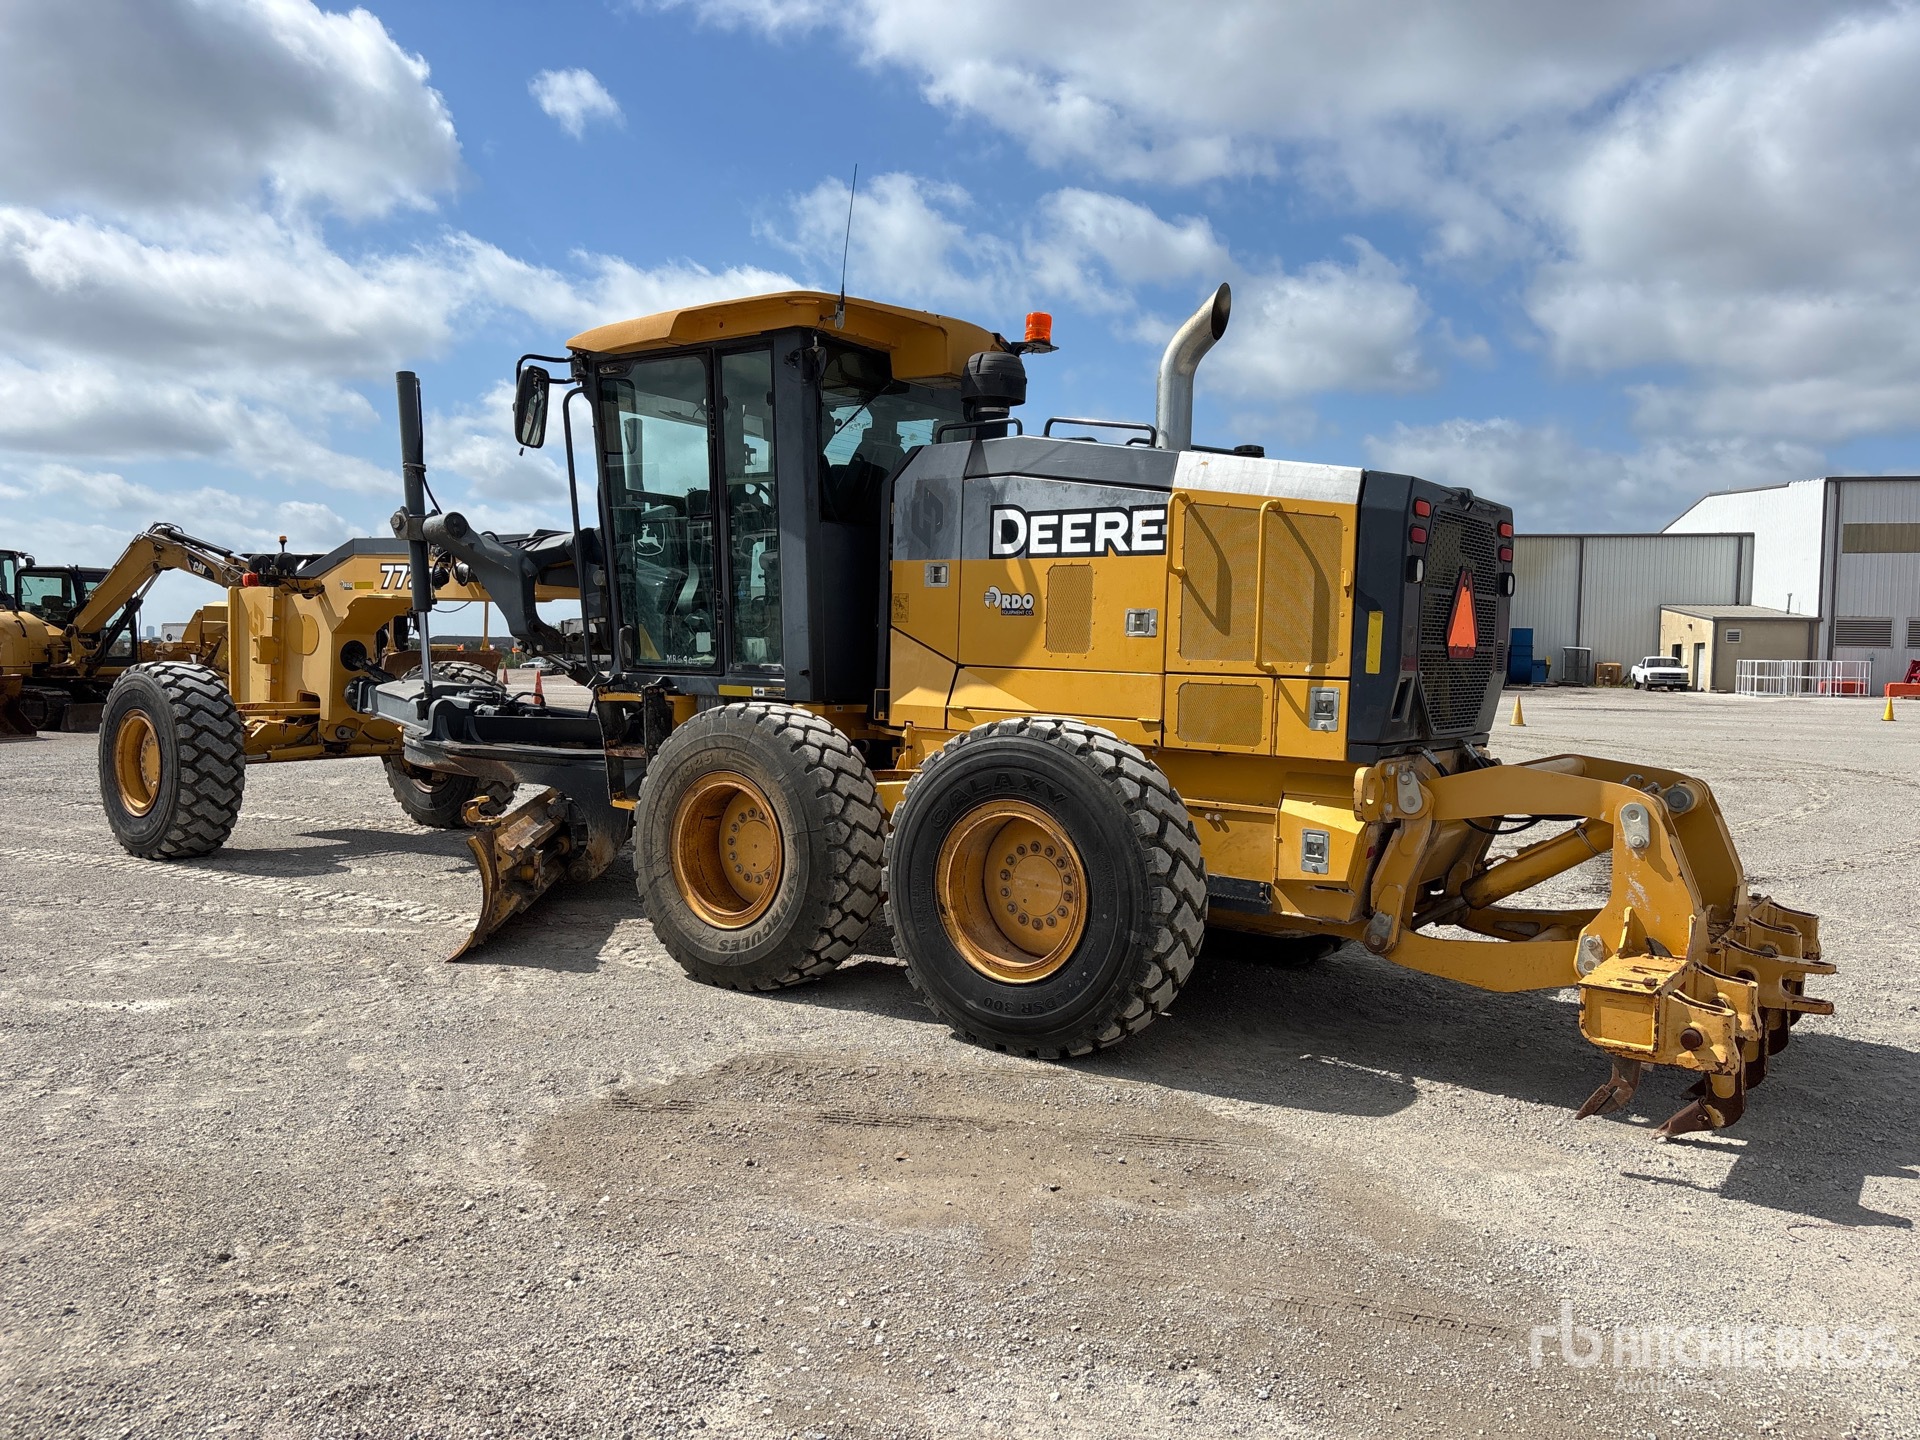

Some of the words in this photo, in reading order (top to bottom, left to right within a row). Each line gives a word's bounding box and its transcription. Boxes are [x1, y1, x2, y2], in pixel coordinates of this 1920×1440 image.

[992, 508, 1166, 556] DEERE
[193, 561, 206, 575] CAT
[930, 772, 1069, 828] GALAXY
[983, 996, 1015, 1014] 300
